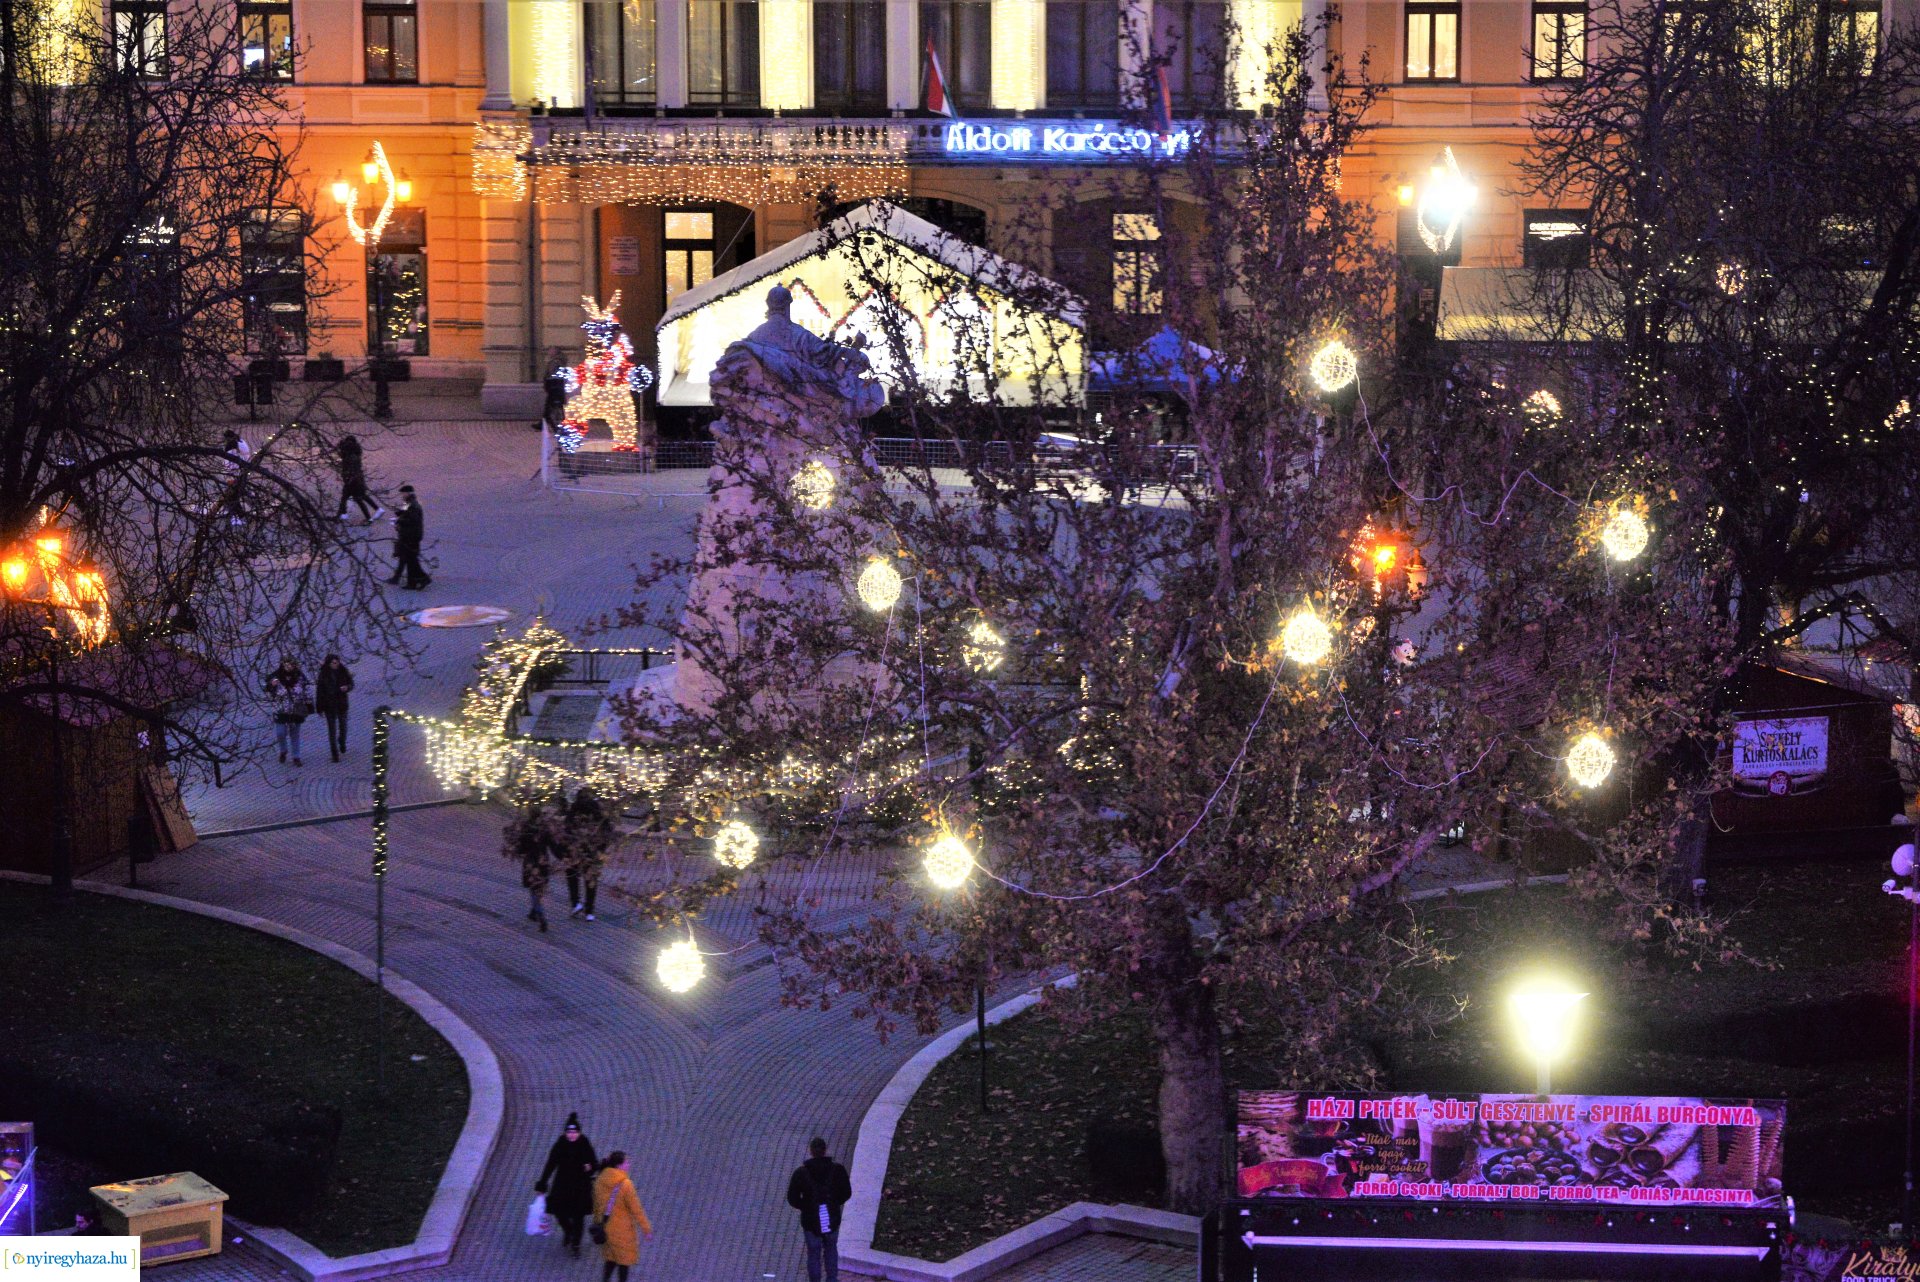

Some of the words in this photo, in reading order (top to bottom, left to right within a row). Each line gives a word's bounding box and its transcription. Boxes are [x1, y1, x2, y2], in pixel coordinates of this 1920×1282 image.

[1308, 1097, 1354, 1118] HÁZI
[1360, 1098, 1416, 1119] PITÉK
[1433, 1098, 1476, 1121] SÜLT
[1481, 1101, 1576, 1121] GESZTENYE
[1590, 1102, 1652, 1123] SPIRÁL
[1657, 1106, 1755, 1126] BURGONYA
[1354, 1181, 1398, 1196] FORRÓ
[1401, 1183, 1442, 1196] CSOKI
[1453, 1184, 1508, 1198] FORRALT
[1511, 1185, 1539, 1199] BOR
[1551, 1186, 1592, 1200] FORRÓ
[1597, 1187, 1619, 1200] TEA
[1674, 1188, 1754, 1202] PALACSINTA
